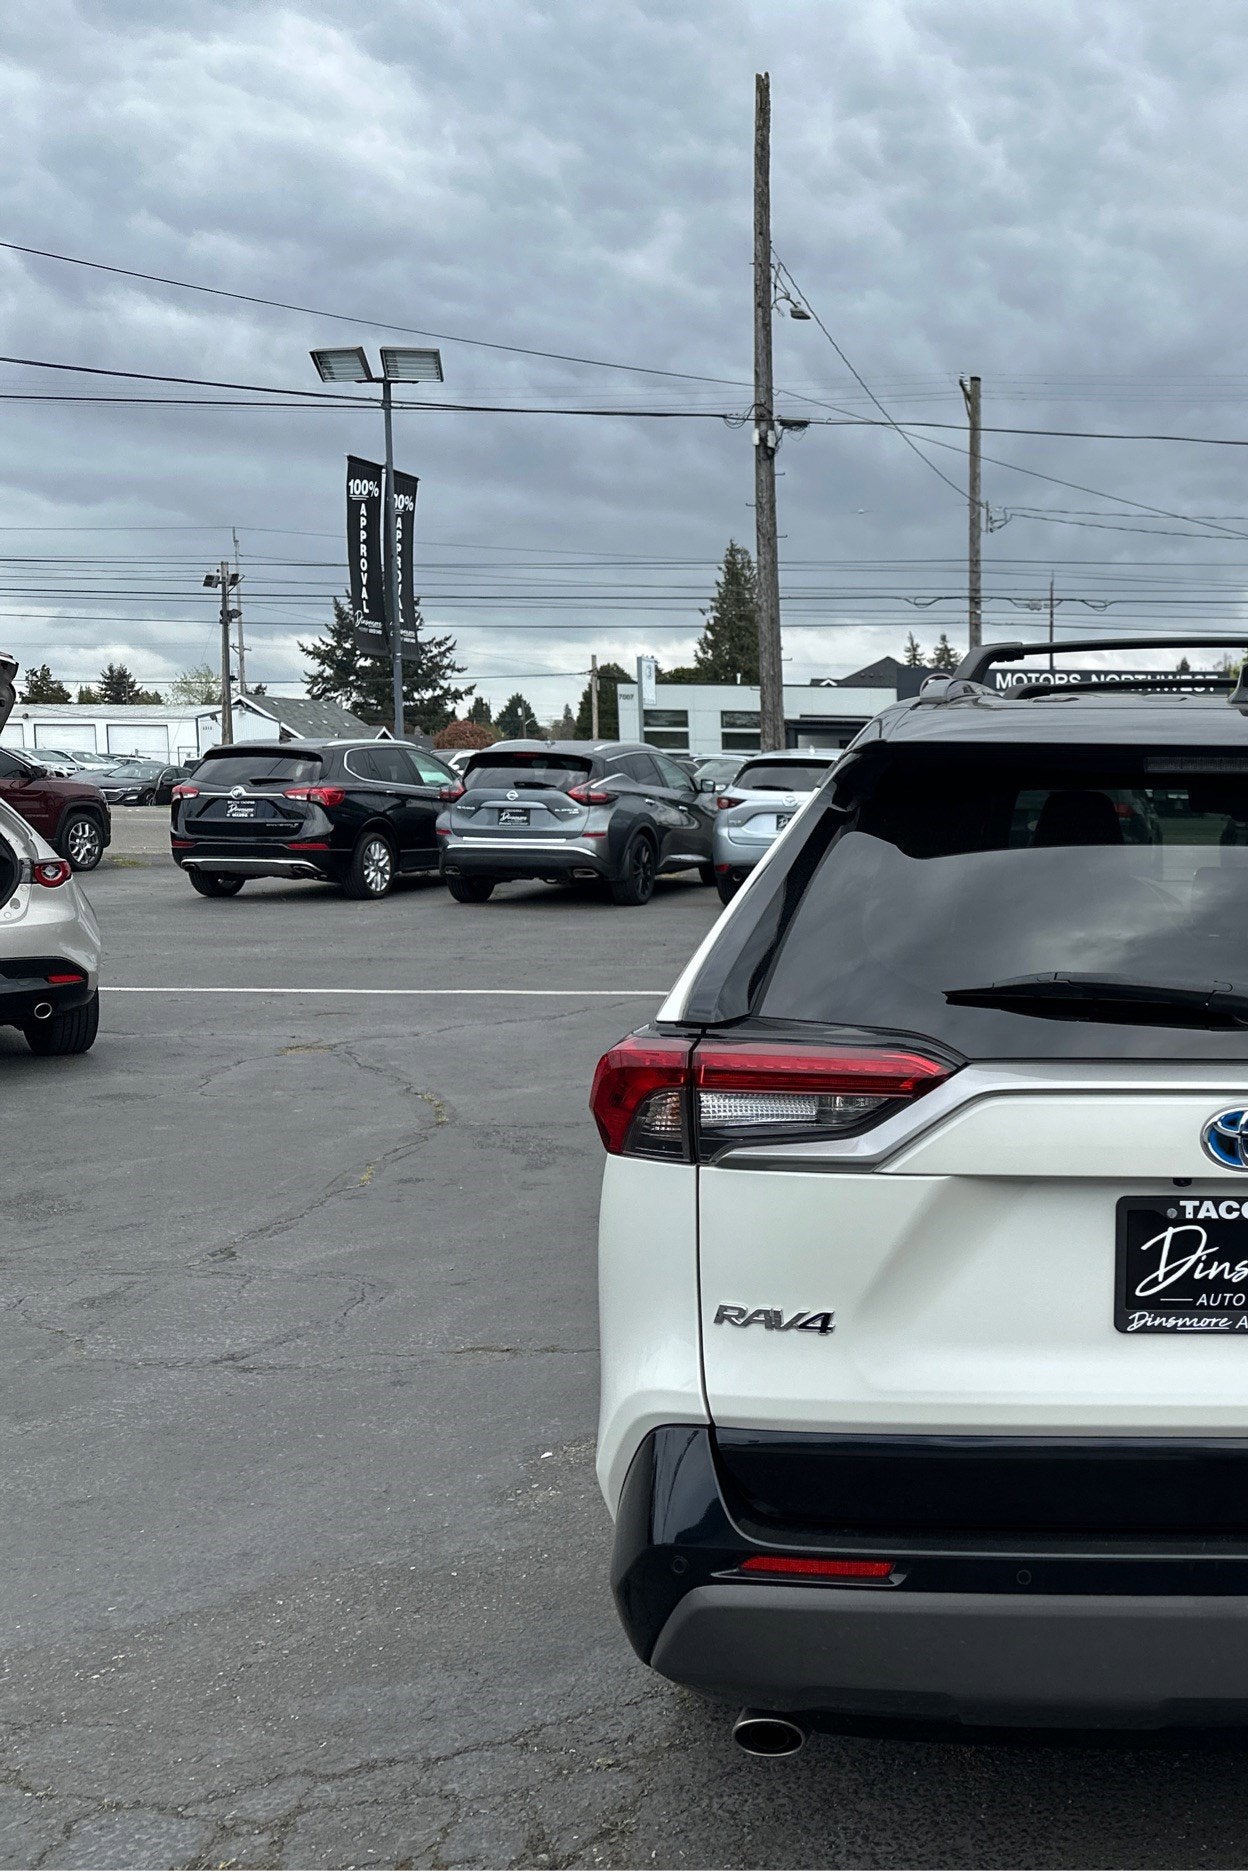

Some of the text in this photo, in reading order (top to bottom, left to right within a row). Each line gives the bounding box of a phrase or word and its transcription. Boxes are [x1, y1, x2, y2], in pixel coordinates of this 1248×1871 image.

[348, 478, 379, 498] 100%
[393, 493, 414, 512] 0%
[359, 502, 370, 614] APPROVAL
[995, 672, 1082, 690] MOTORS
[1196, 1293, 1246, 1306] AUTO
[713, 1302, 836, 1336] RAV4
[1127, 1311, 1233, 1331] Dinsmore
